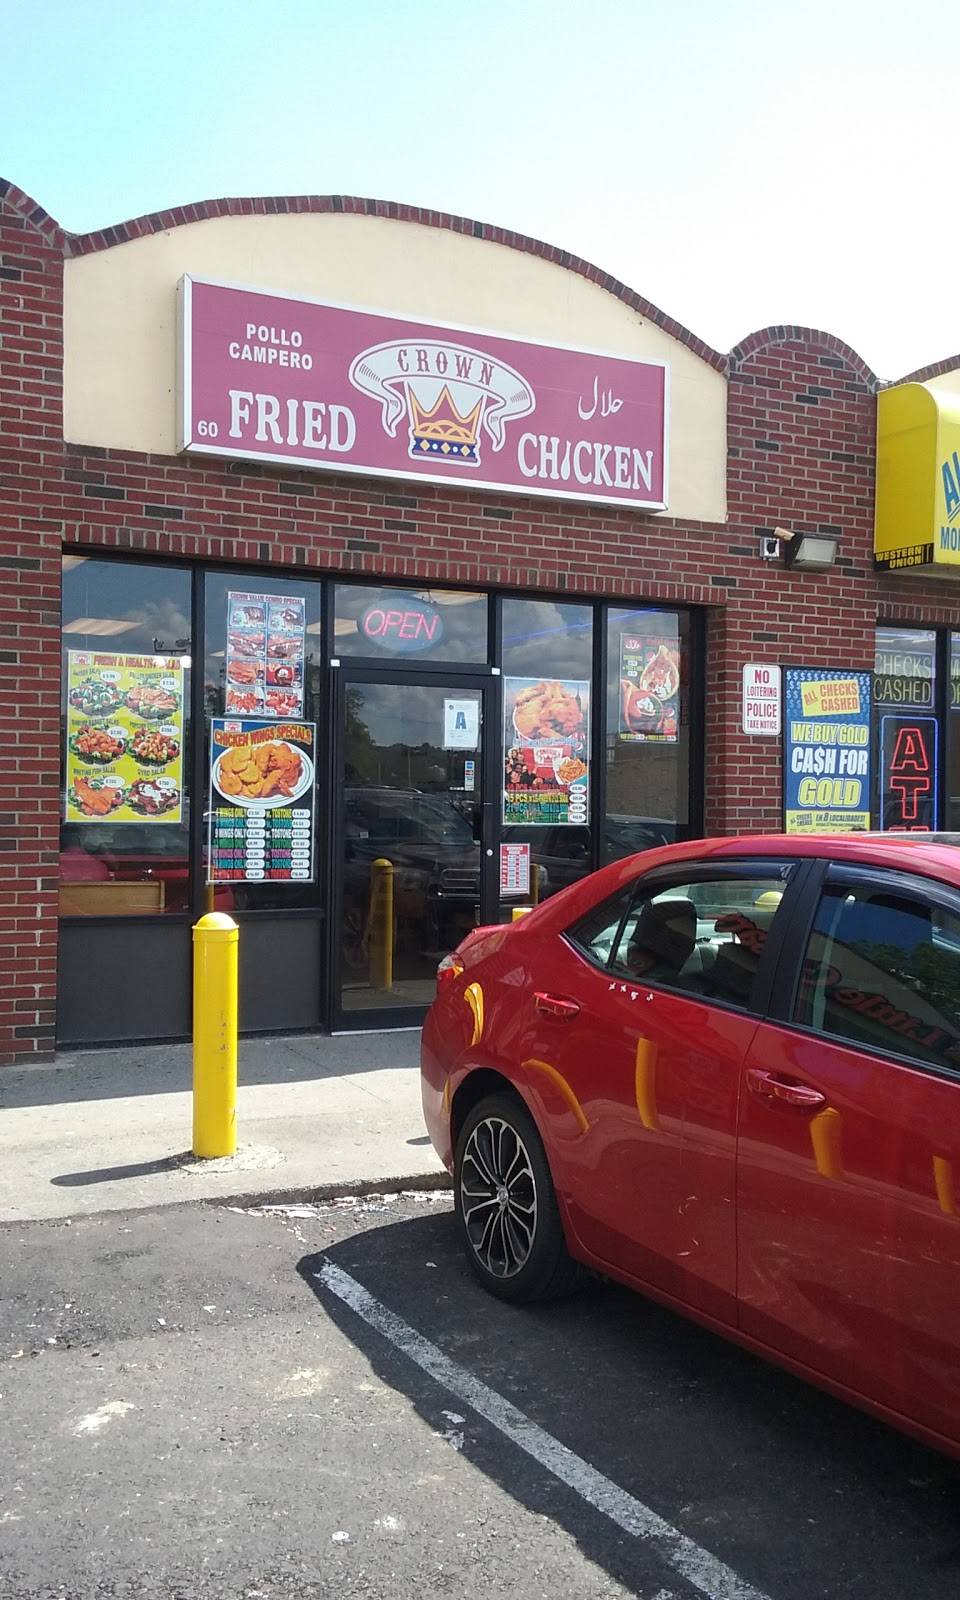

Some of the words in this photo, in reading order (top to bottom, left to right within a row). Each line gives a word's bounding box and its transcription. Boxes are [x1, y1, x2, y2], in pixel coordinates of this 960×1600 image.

[246, 323, 303, 348] POLLO
[228, 342, 313, 371] CAMPERO
[397, 348, 495, 390] CROWN
[577, 375, 624, 422] حلال
[198, 420, 218, 438] 60
[228, 390, 357, 453] FRIED
[517, 432, 654, 492] CHICKEN
[940, 527, 960, 550] MO
[876, 546, 922, 562] WESTERN
[889, 556, 922, 568] UNION
[364, 609, 440, 640] OPEN
[754, 670, 770, 684] NO
[874, 654, 931, 678] CHECKS
[747, 686, 777, 697] LOITERING
[804, 690, 818, 706] ALL
[820, 682, 857, 697] CHECKS
[874, 678, 932, 704] CASHED
[747, 703, 777, 717] POLICE
[821, 697, 858, 711] CASHED
[455, 712, 467, 729] A
[747, 720, 758, 728] TAKE
[760, 720, 777, 729] NOTICE
[214, 728, 249, 747] CHICKEN
[250, 726, 275, 744] WINGS
[792, 724, 812, 742] WE
[813, 724, 837, 745] BUY
[839, 725, 869, 746] GOLD
[791, 746, 836, 776] CA$H
[838, 750, 868, 776] FOR
[889, 728, 930, 832] AT
[798, 776, 862, 807] GOLD
[824, 813, 829, 821] 8
